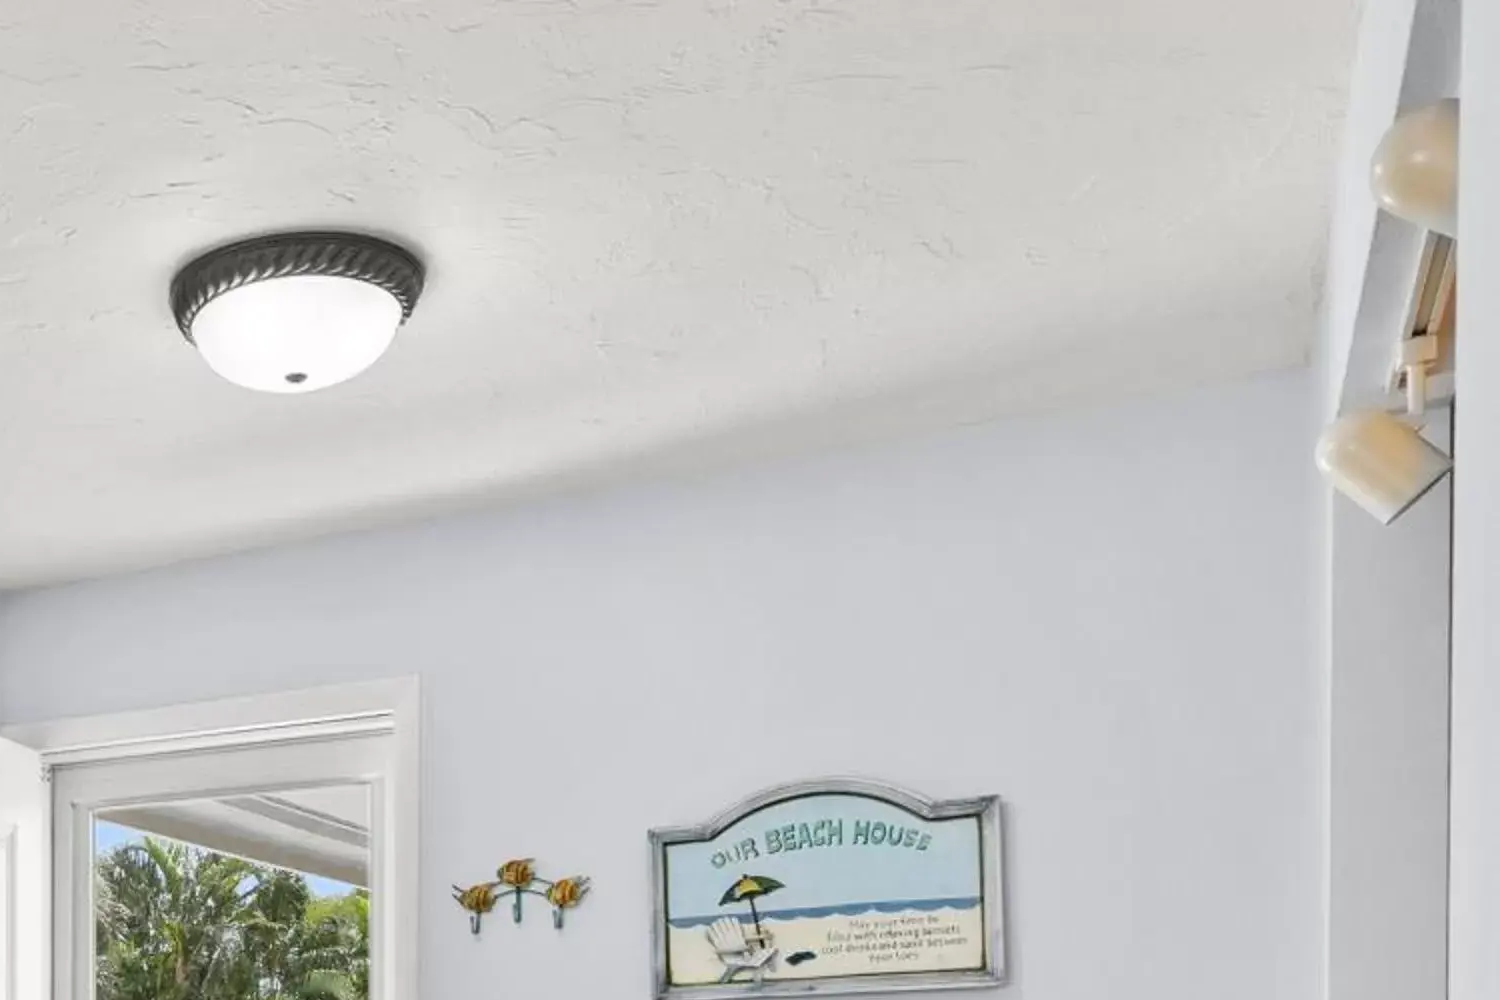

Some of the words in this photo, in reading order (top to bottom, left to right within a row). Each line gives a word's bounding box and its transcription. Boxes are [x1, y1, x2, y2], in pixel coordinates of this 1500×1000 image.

[710, 837, 760, 869] OUR
[765, 818, 843, 855] BEACH
[852, 819, 933, 851] HOUSE
